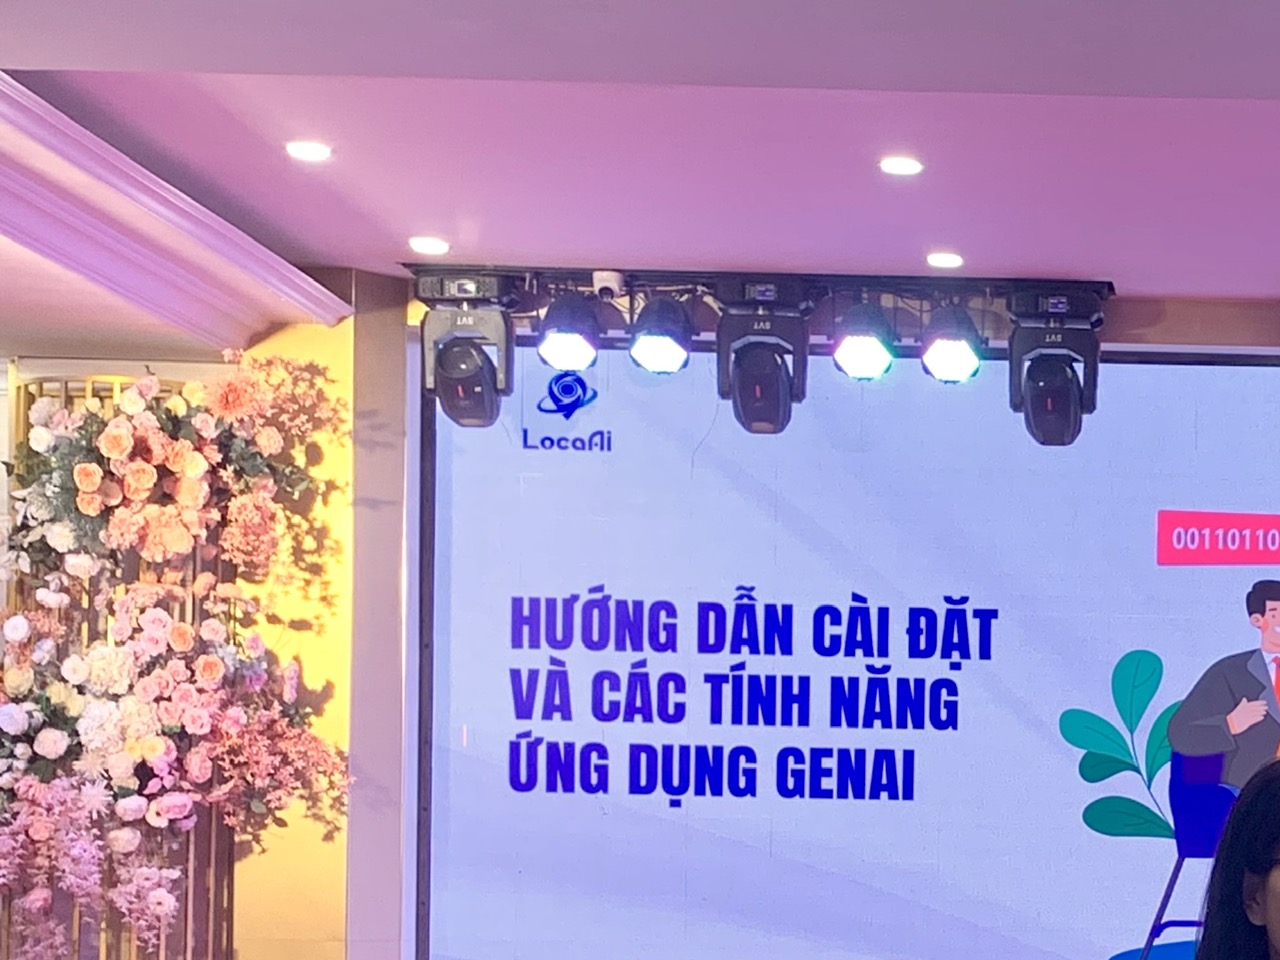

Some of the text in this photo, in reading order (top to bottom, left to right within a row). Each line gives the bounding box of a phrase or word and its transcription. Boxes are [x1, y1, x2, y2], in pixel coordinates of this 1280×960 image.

[511, 583, 1000, 672] HƯỚNG DẪN CÀI ĐẶT
[509, 655, 959, 732] VÀ CÁC TÍNH NĂNG
[508, 729, 916, 809] ỨNG DỤNG GENAI
